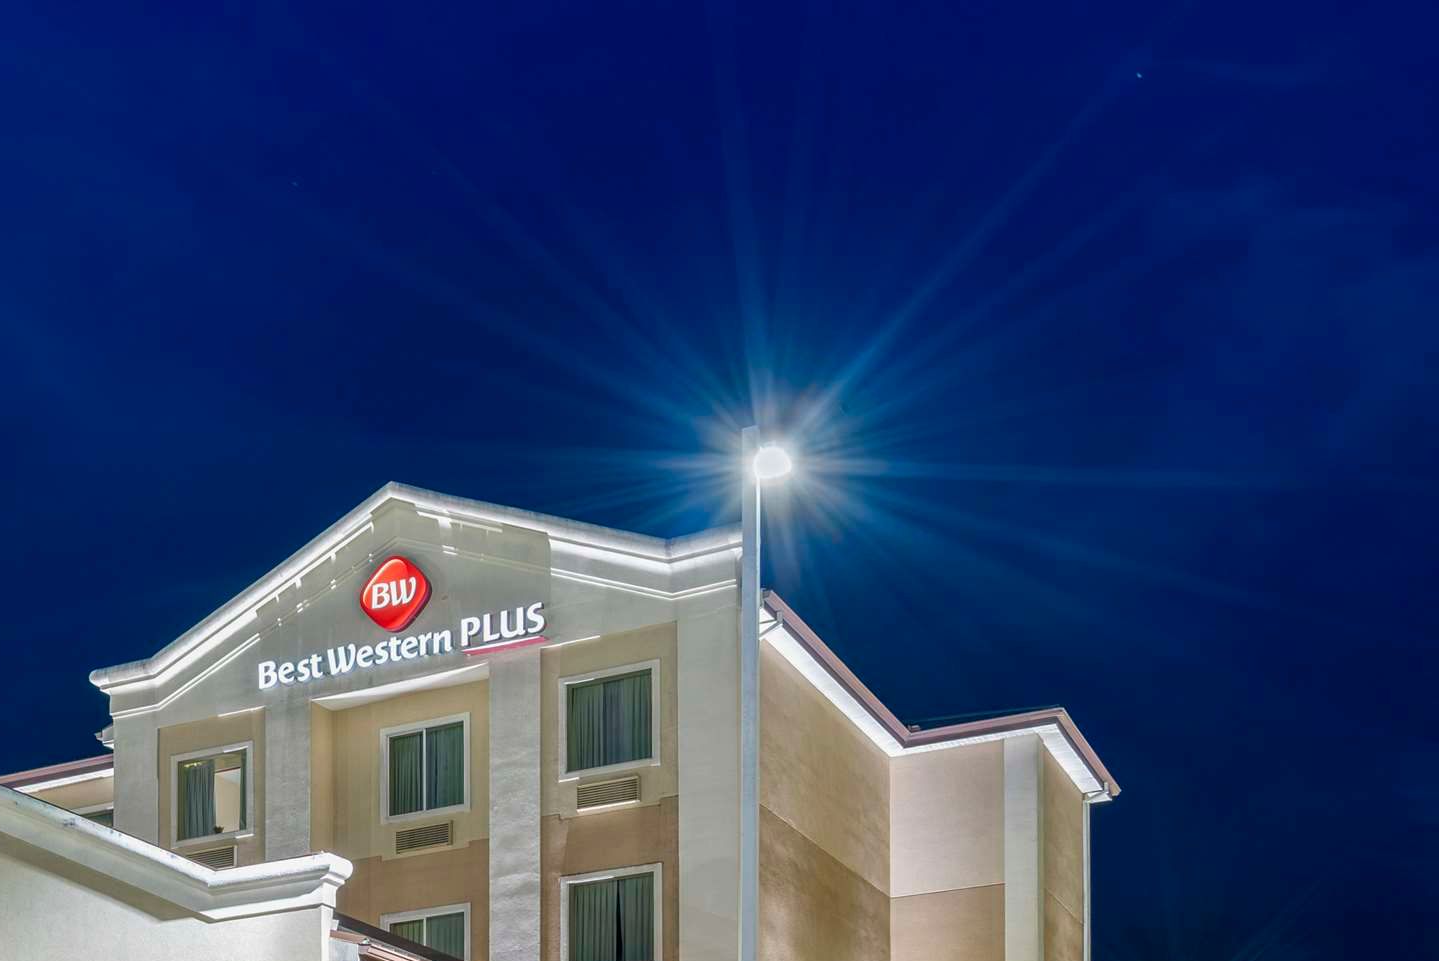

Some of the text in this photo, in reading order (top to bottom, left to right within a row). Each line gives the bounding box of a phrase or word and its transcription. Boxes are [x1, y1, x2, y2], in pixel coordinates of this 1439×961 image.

[371, 576, 417, 609] BW
[258, 601, 546, 689] Best Western PLUS
